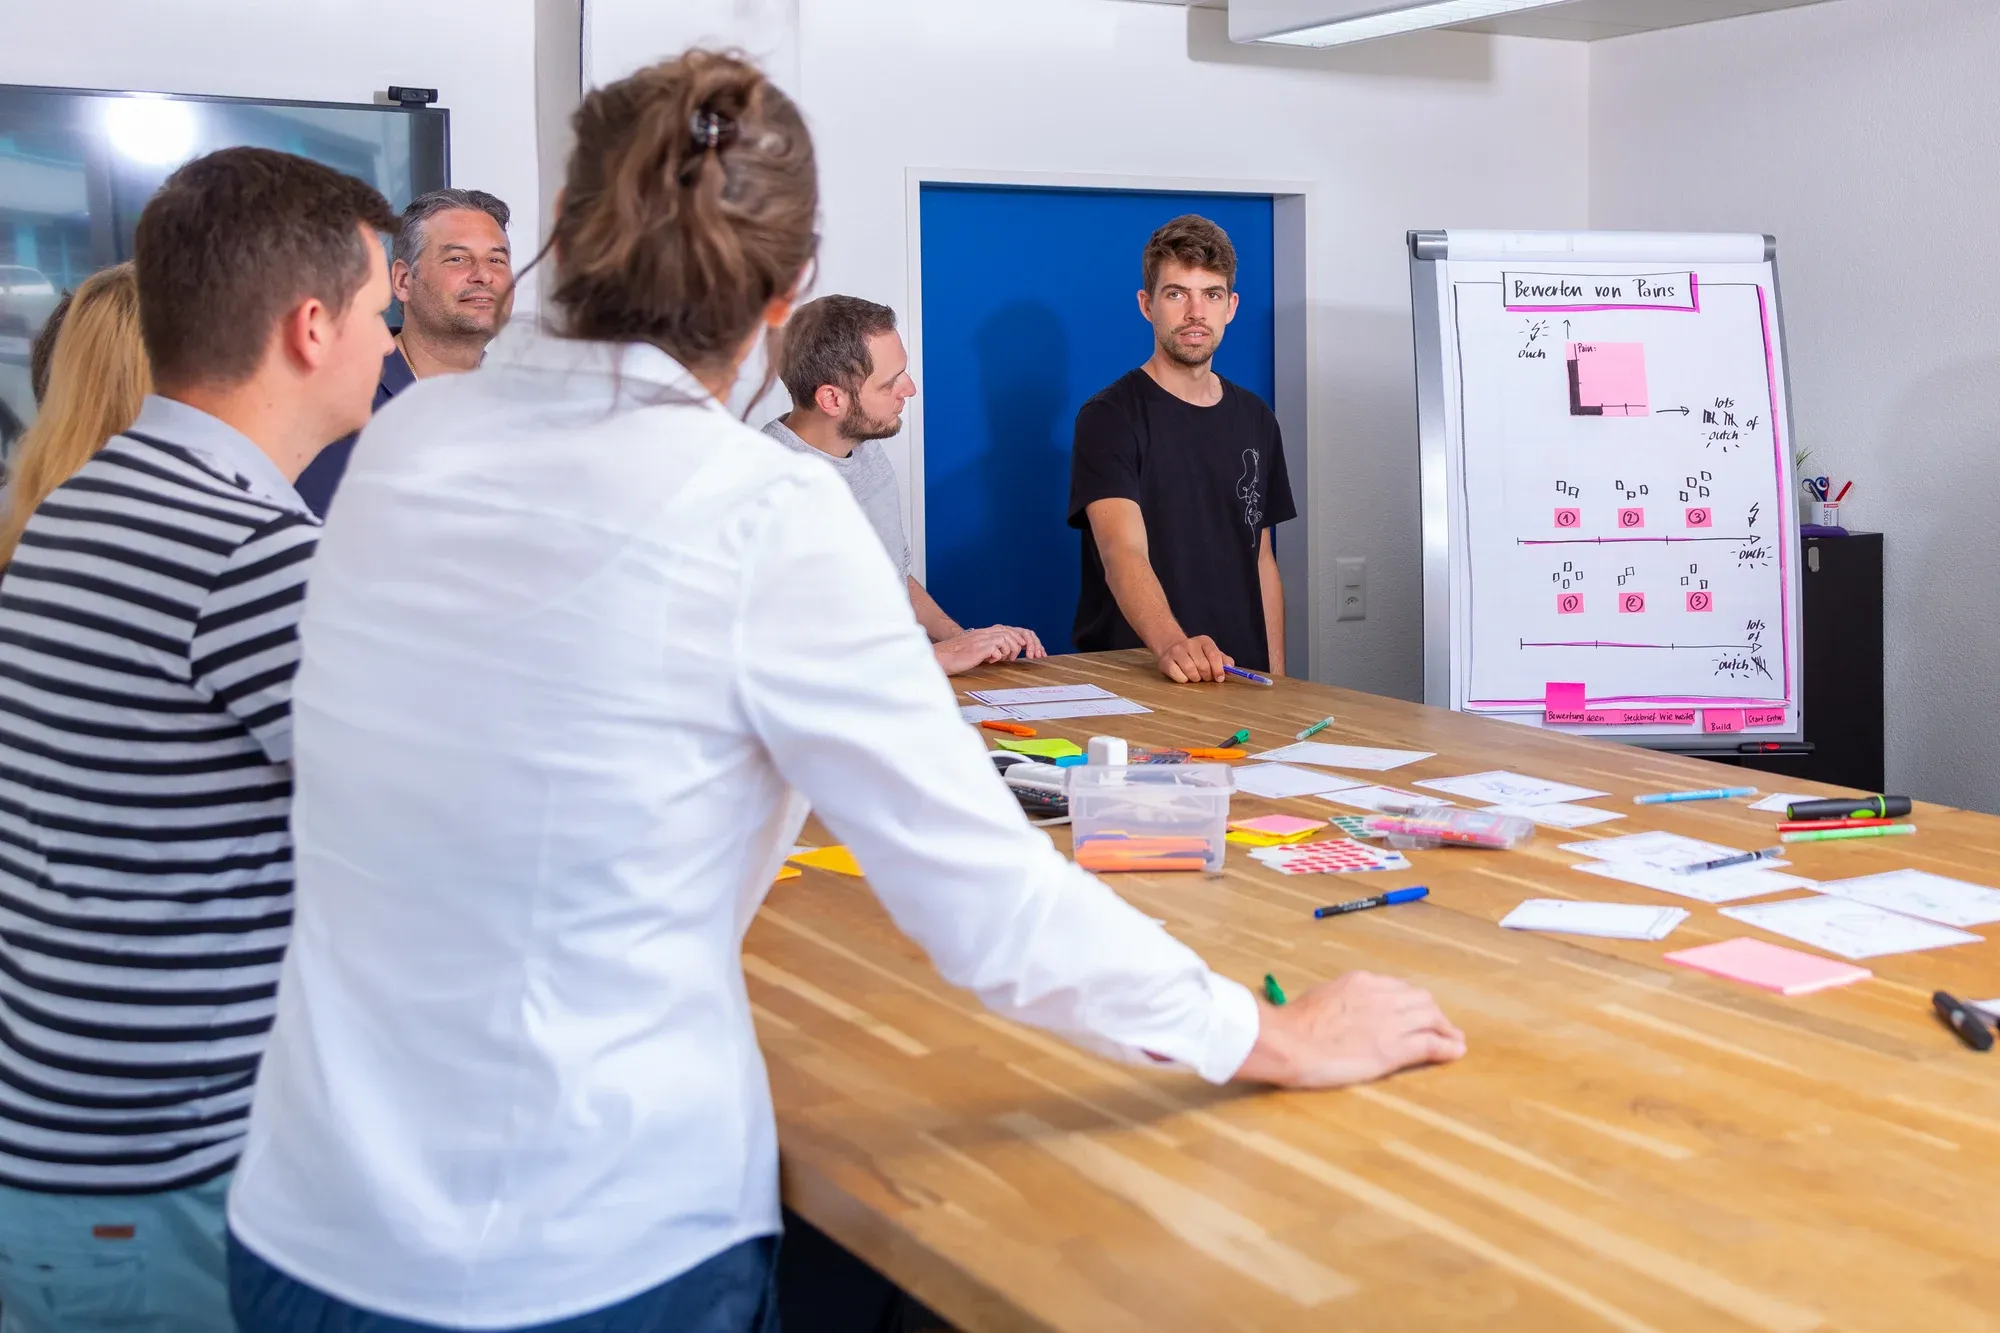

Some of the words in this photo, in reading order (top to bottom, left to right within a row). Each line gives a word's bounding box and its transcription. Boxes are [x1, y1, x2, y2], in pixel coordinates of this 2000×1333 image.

[1514, 280, 1583, 298] Bewerten
[1594, 285, 1622, 298] von
[1632, 278, 1675, 298] Pains
[1714, 397, 1735, 408] lots
[1746, 415, 1760, 431] of
[1739, 547, 1766, 559] ouch
[1548, 711, 1585, 722] Bewertung
[1623, 712, 1657, 722] Steckbrief
[1710, 722, 1732, 731] Build
